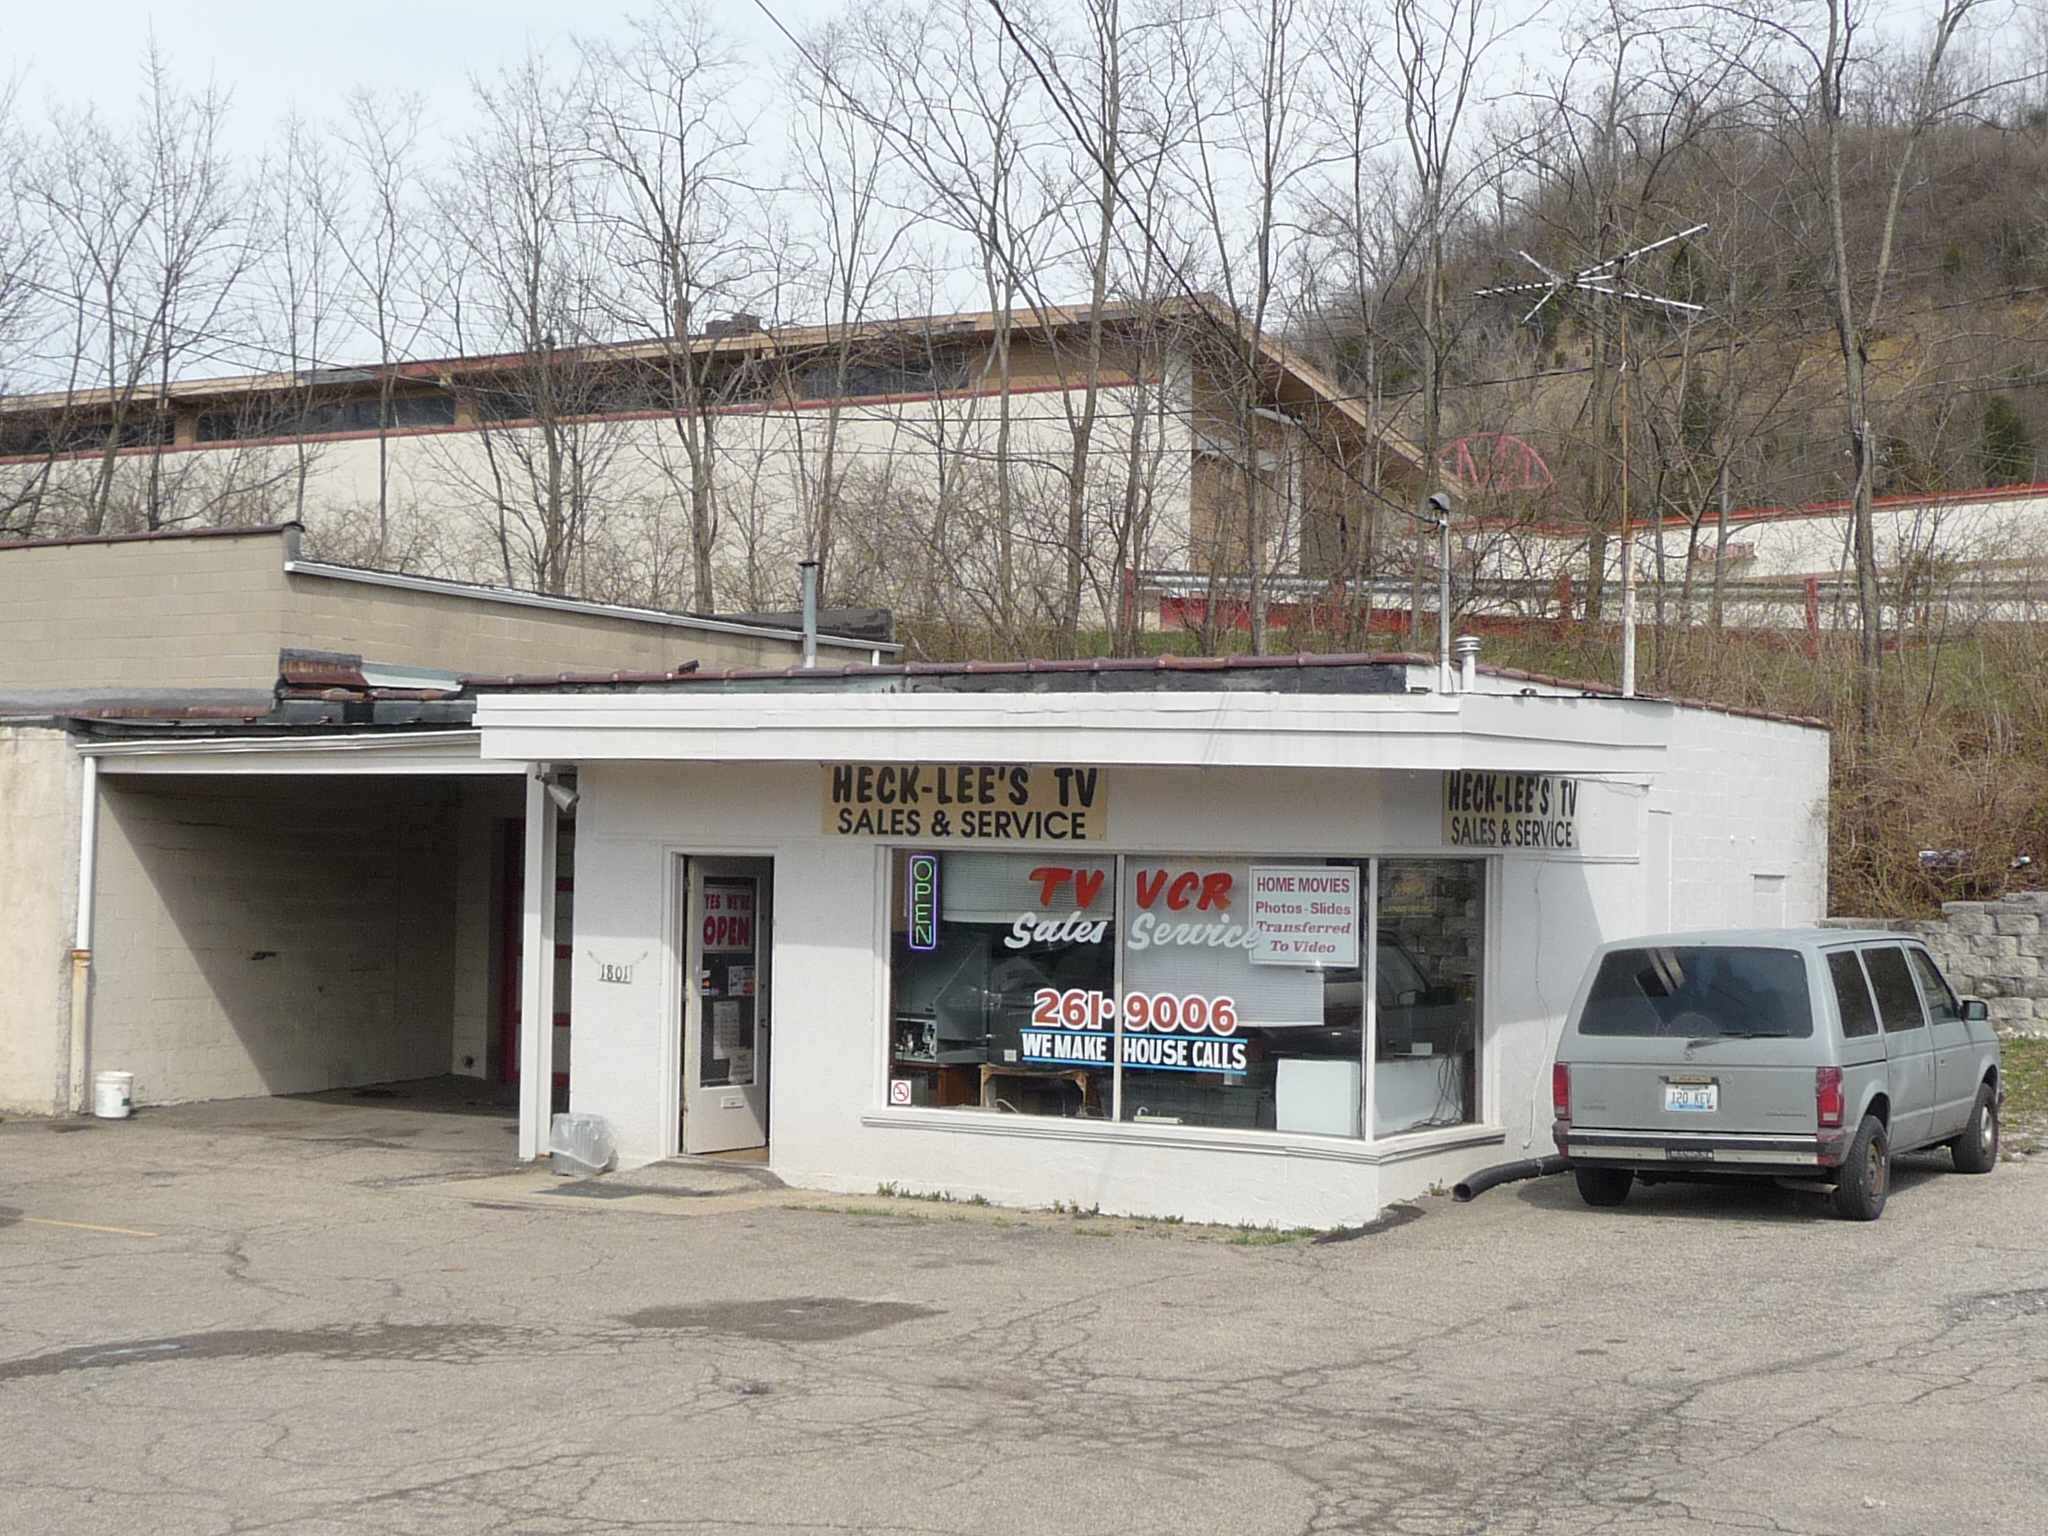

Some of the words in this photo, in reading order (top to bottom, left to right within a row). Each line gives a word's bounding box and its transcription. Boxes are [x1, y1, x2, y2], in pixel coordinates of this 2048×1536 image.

[832, 765, 1029, 806] HECK-LEE'S
[1053, 767, 1097, 808] TV
[1449, 771, 1549, 815] HECK-LEE'S
[1560, 779, 1577, 817] TV
[837, 807, 921, 836] SALES
[931, 810, 951, 837] &
[960, 811, 1086, 840] SERVICE
[1451, 816, 1496, 845] SALES
[1501, 818, 1511, 846] &
[1515, 819, 1572, 847] SERVICE
[1029, 866, 1105, 909] TV
[1136, 869, 1233, 911] VCR
[1257, 877, 1295, 892] HOME
[1298, 878, 1350, 893] MOVIES
[705, 894, 721, 910] YES
[913, 860, 933, 945] OPEN
[1256, 901, 1302, 914] Photos
[1310, 902, 1351, 915] Slides
[703, 915, 751, 946] OPEN
[1004, 911, 1108, 949] Sales
[1127, 912, 1261, 950] Service
[1257, 921, 1351, 934] Transferred
[1270, 940, 1289, 952] To
[1293, 941, 1336, 954] Video
[601, 963, 628, 981] 1801
[1022, 1033, 1052, 1056] WE
[1054, 1035, 1106, 1061] MAKE
[1123, 1038, 1187, 1066] HOUSE
[1192, 1041, 1247, 1070] CALLS
[1671, 1091, 1689, 1104] 120
